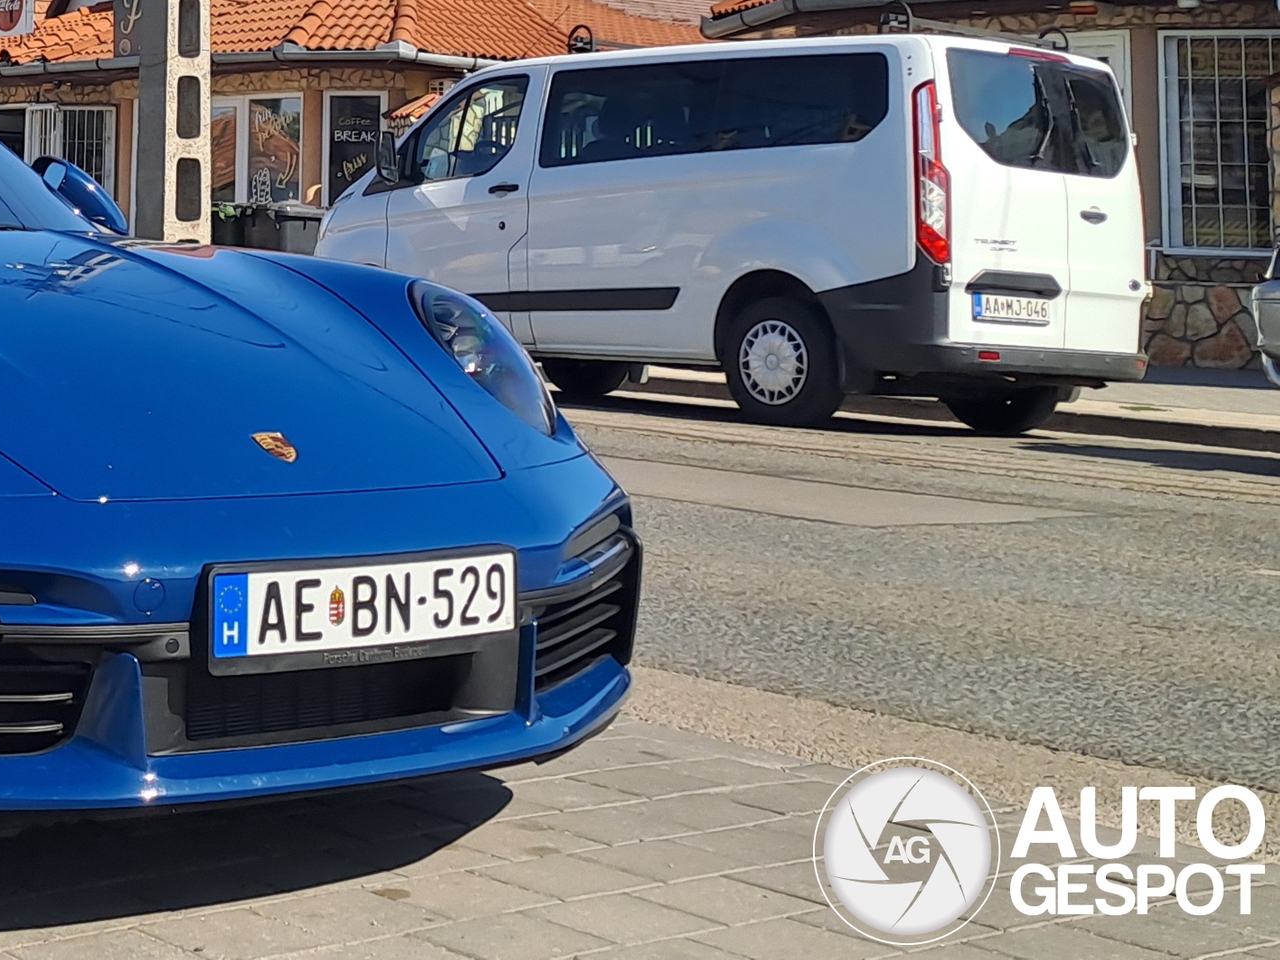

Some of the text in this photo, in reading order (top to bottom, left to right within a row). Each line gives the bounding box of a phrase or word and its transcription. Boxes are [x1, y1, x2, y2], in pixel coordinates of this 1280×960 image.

[334, 129, 377, 142] BREAK
[984, 297, 1048, 319] AA MJ-046
[222, 562, 507, 646] H AE BN-529
